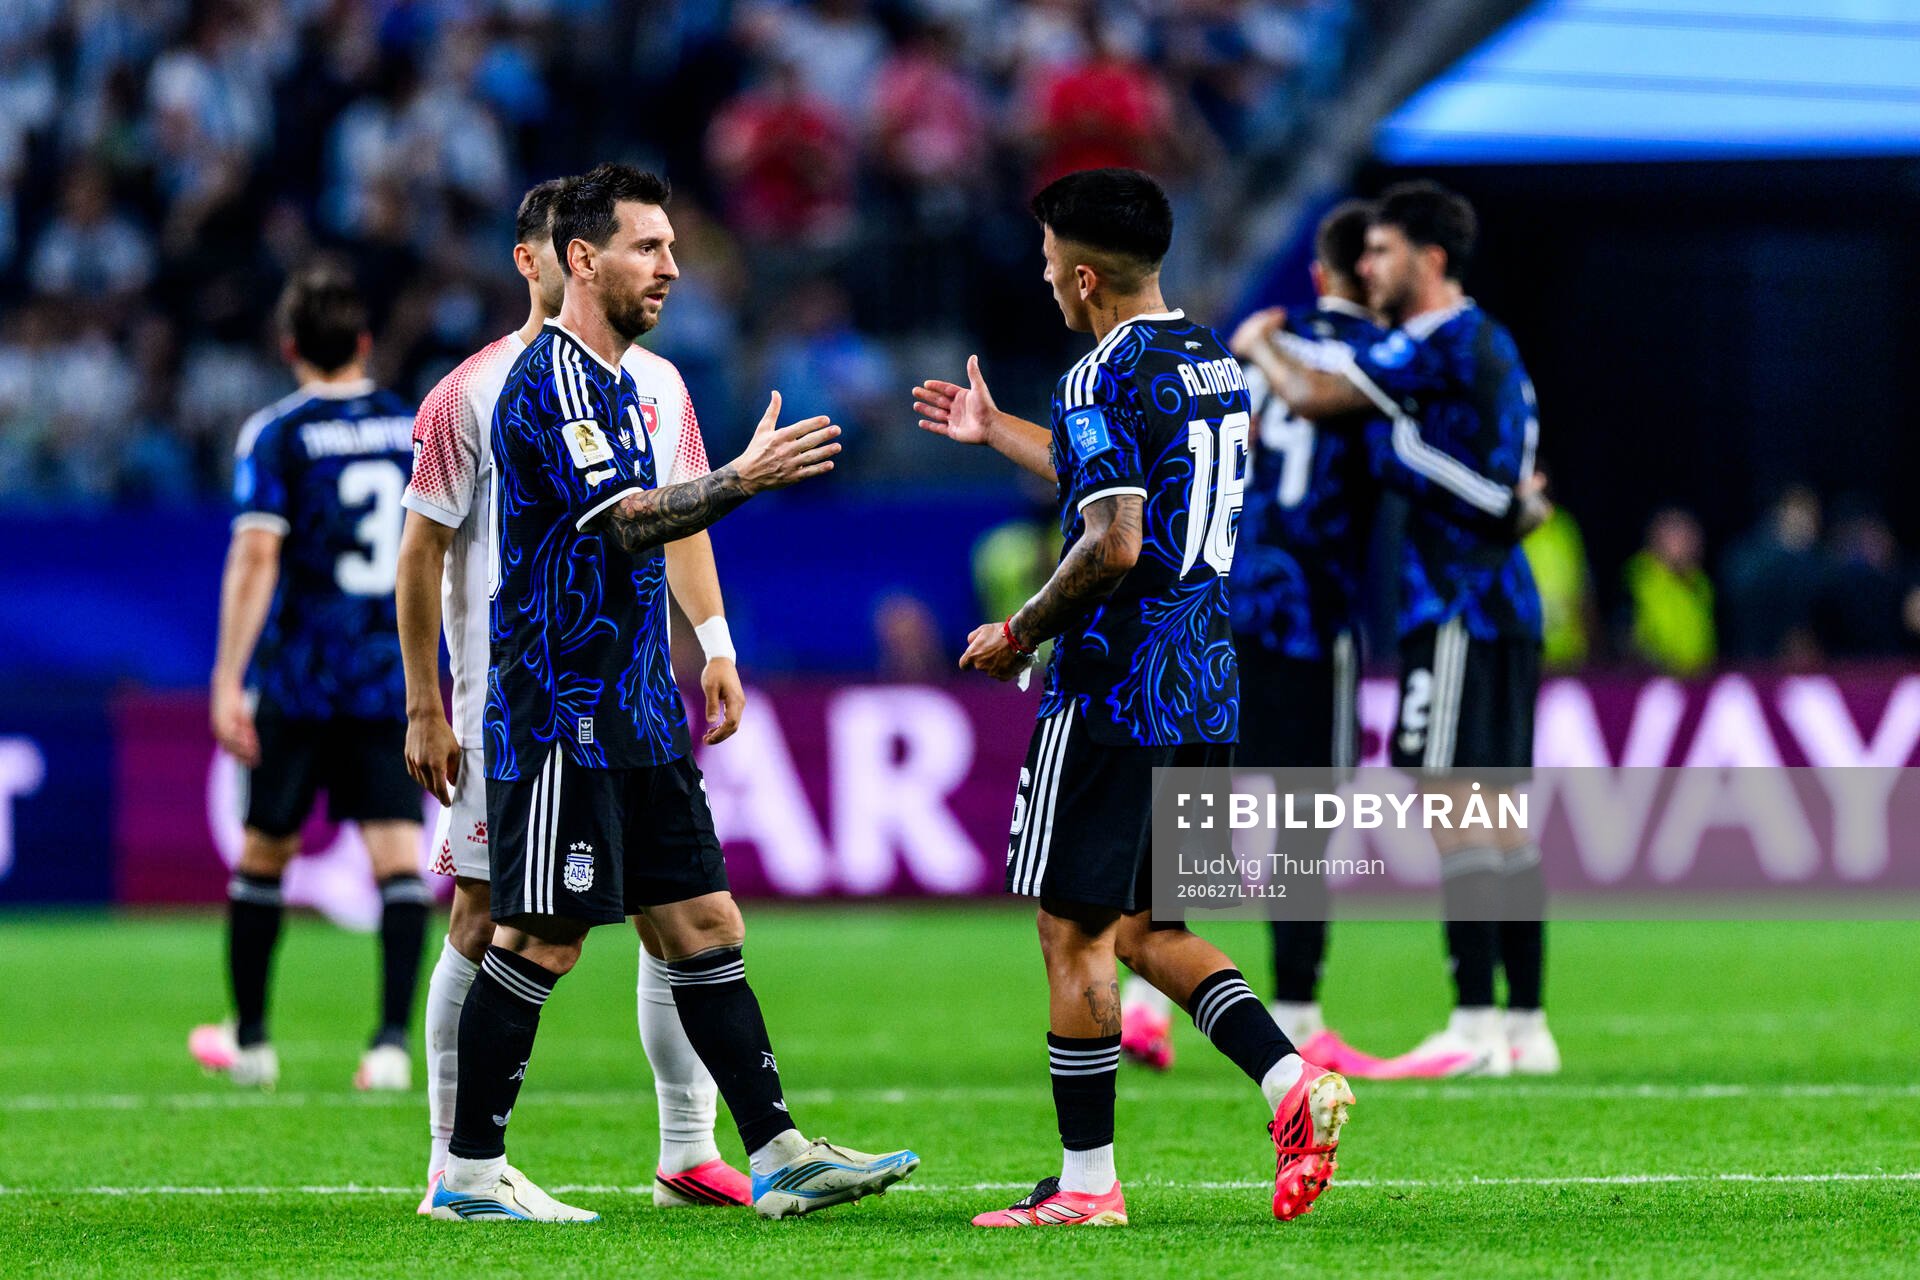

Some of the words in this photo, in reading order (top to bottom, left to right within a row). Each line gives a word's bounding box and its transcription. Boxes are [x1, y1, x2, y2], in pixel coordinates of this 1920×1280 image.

[1177, 357, 1248, 397] ALMADA
[1179, 411, 1249, 581] 16
[336, 459, 404, 596] 3
[1402, 668, 1432, 730] 2
[467, 835, 488, 845] KELM
[570, 864, 587, 881] AFA
